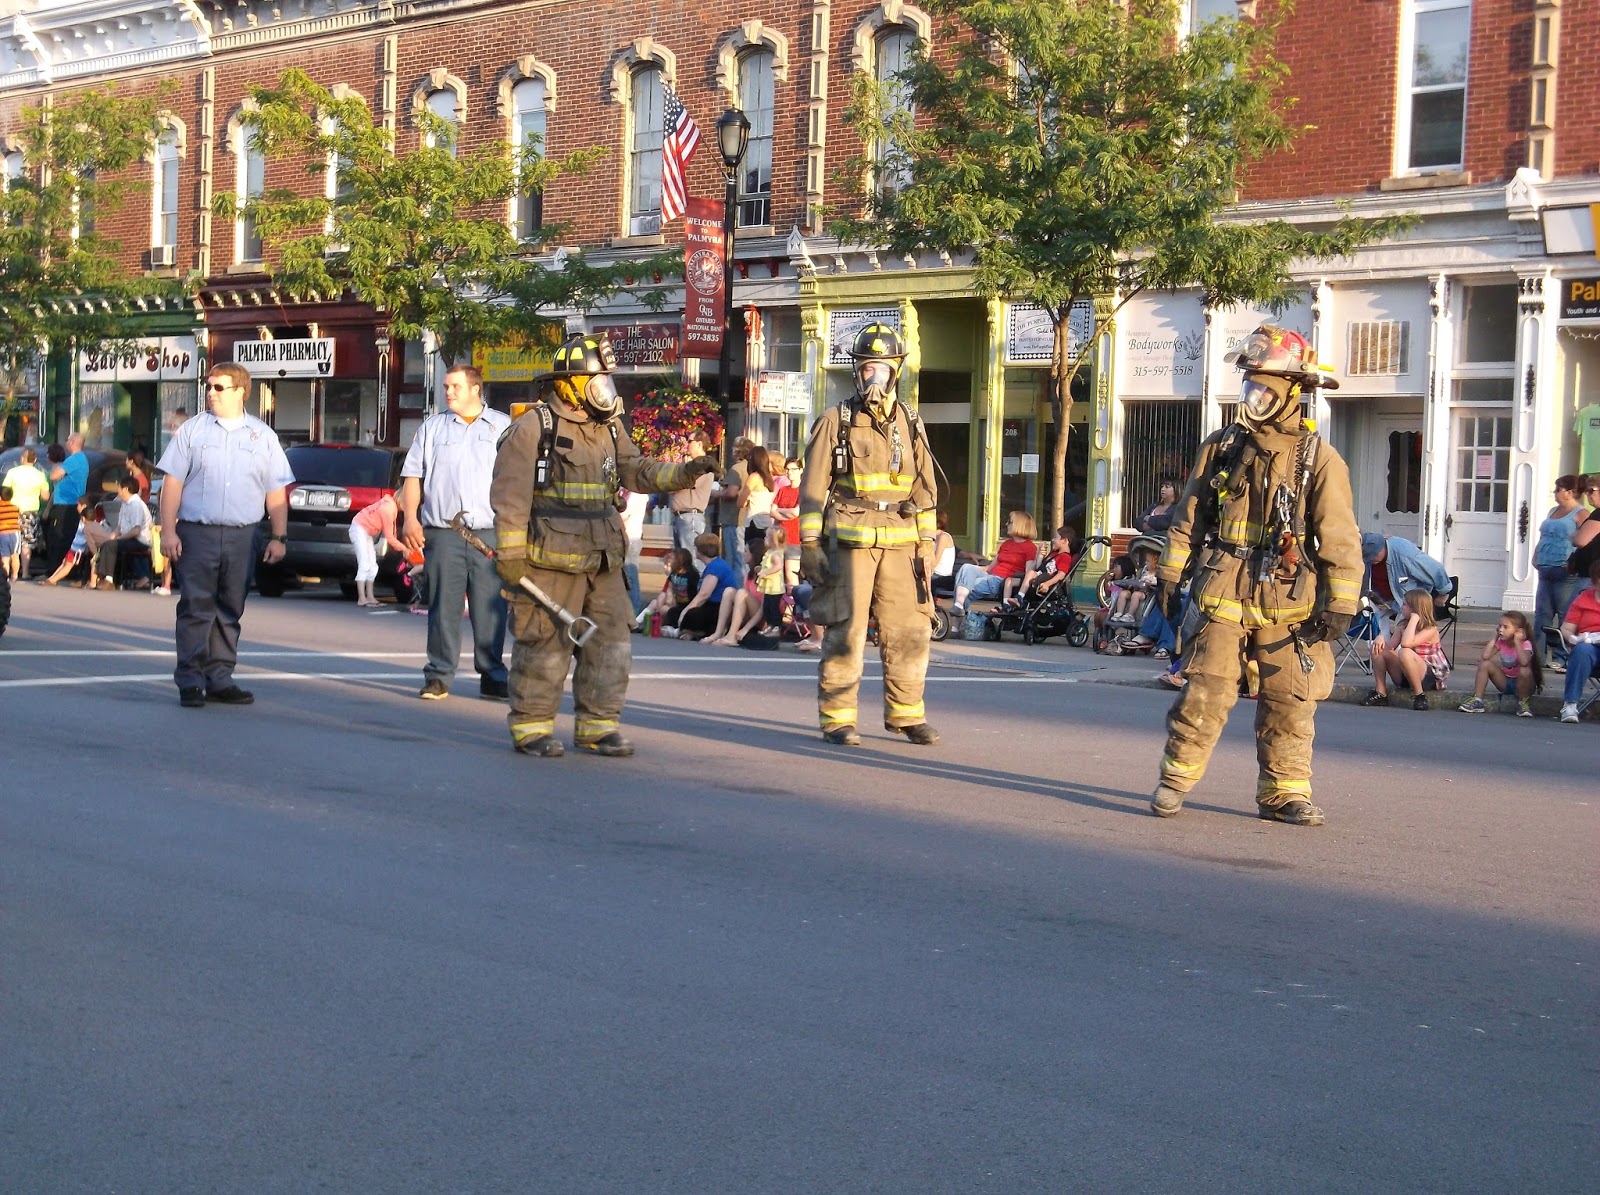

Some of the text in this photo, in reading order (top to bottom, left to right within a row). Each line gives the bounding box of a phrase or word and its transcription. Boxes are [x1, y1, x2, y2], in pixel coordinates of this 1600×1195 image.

[687, 217, 723, 228] WELCOME
[688, 233, 723, 244] PALMYRA
[1566, 307, 1584, 315] Youth
[626, 326, 643, 338] THE
[687, 333, 720, 342] 597-3835
[627, 338, 647, 351] HAIR
[647, 336, 674, 350] SALON
[1129, 336, 1184, 355] Bodyworks
[238, 341, 329, 362] PALMYRA PHARMACY
[145, 346, 190, 375] Shop
[1132, 365, 1194, 377] 315-597-5518
